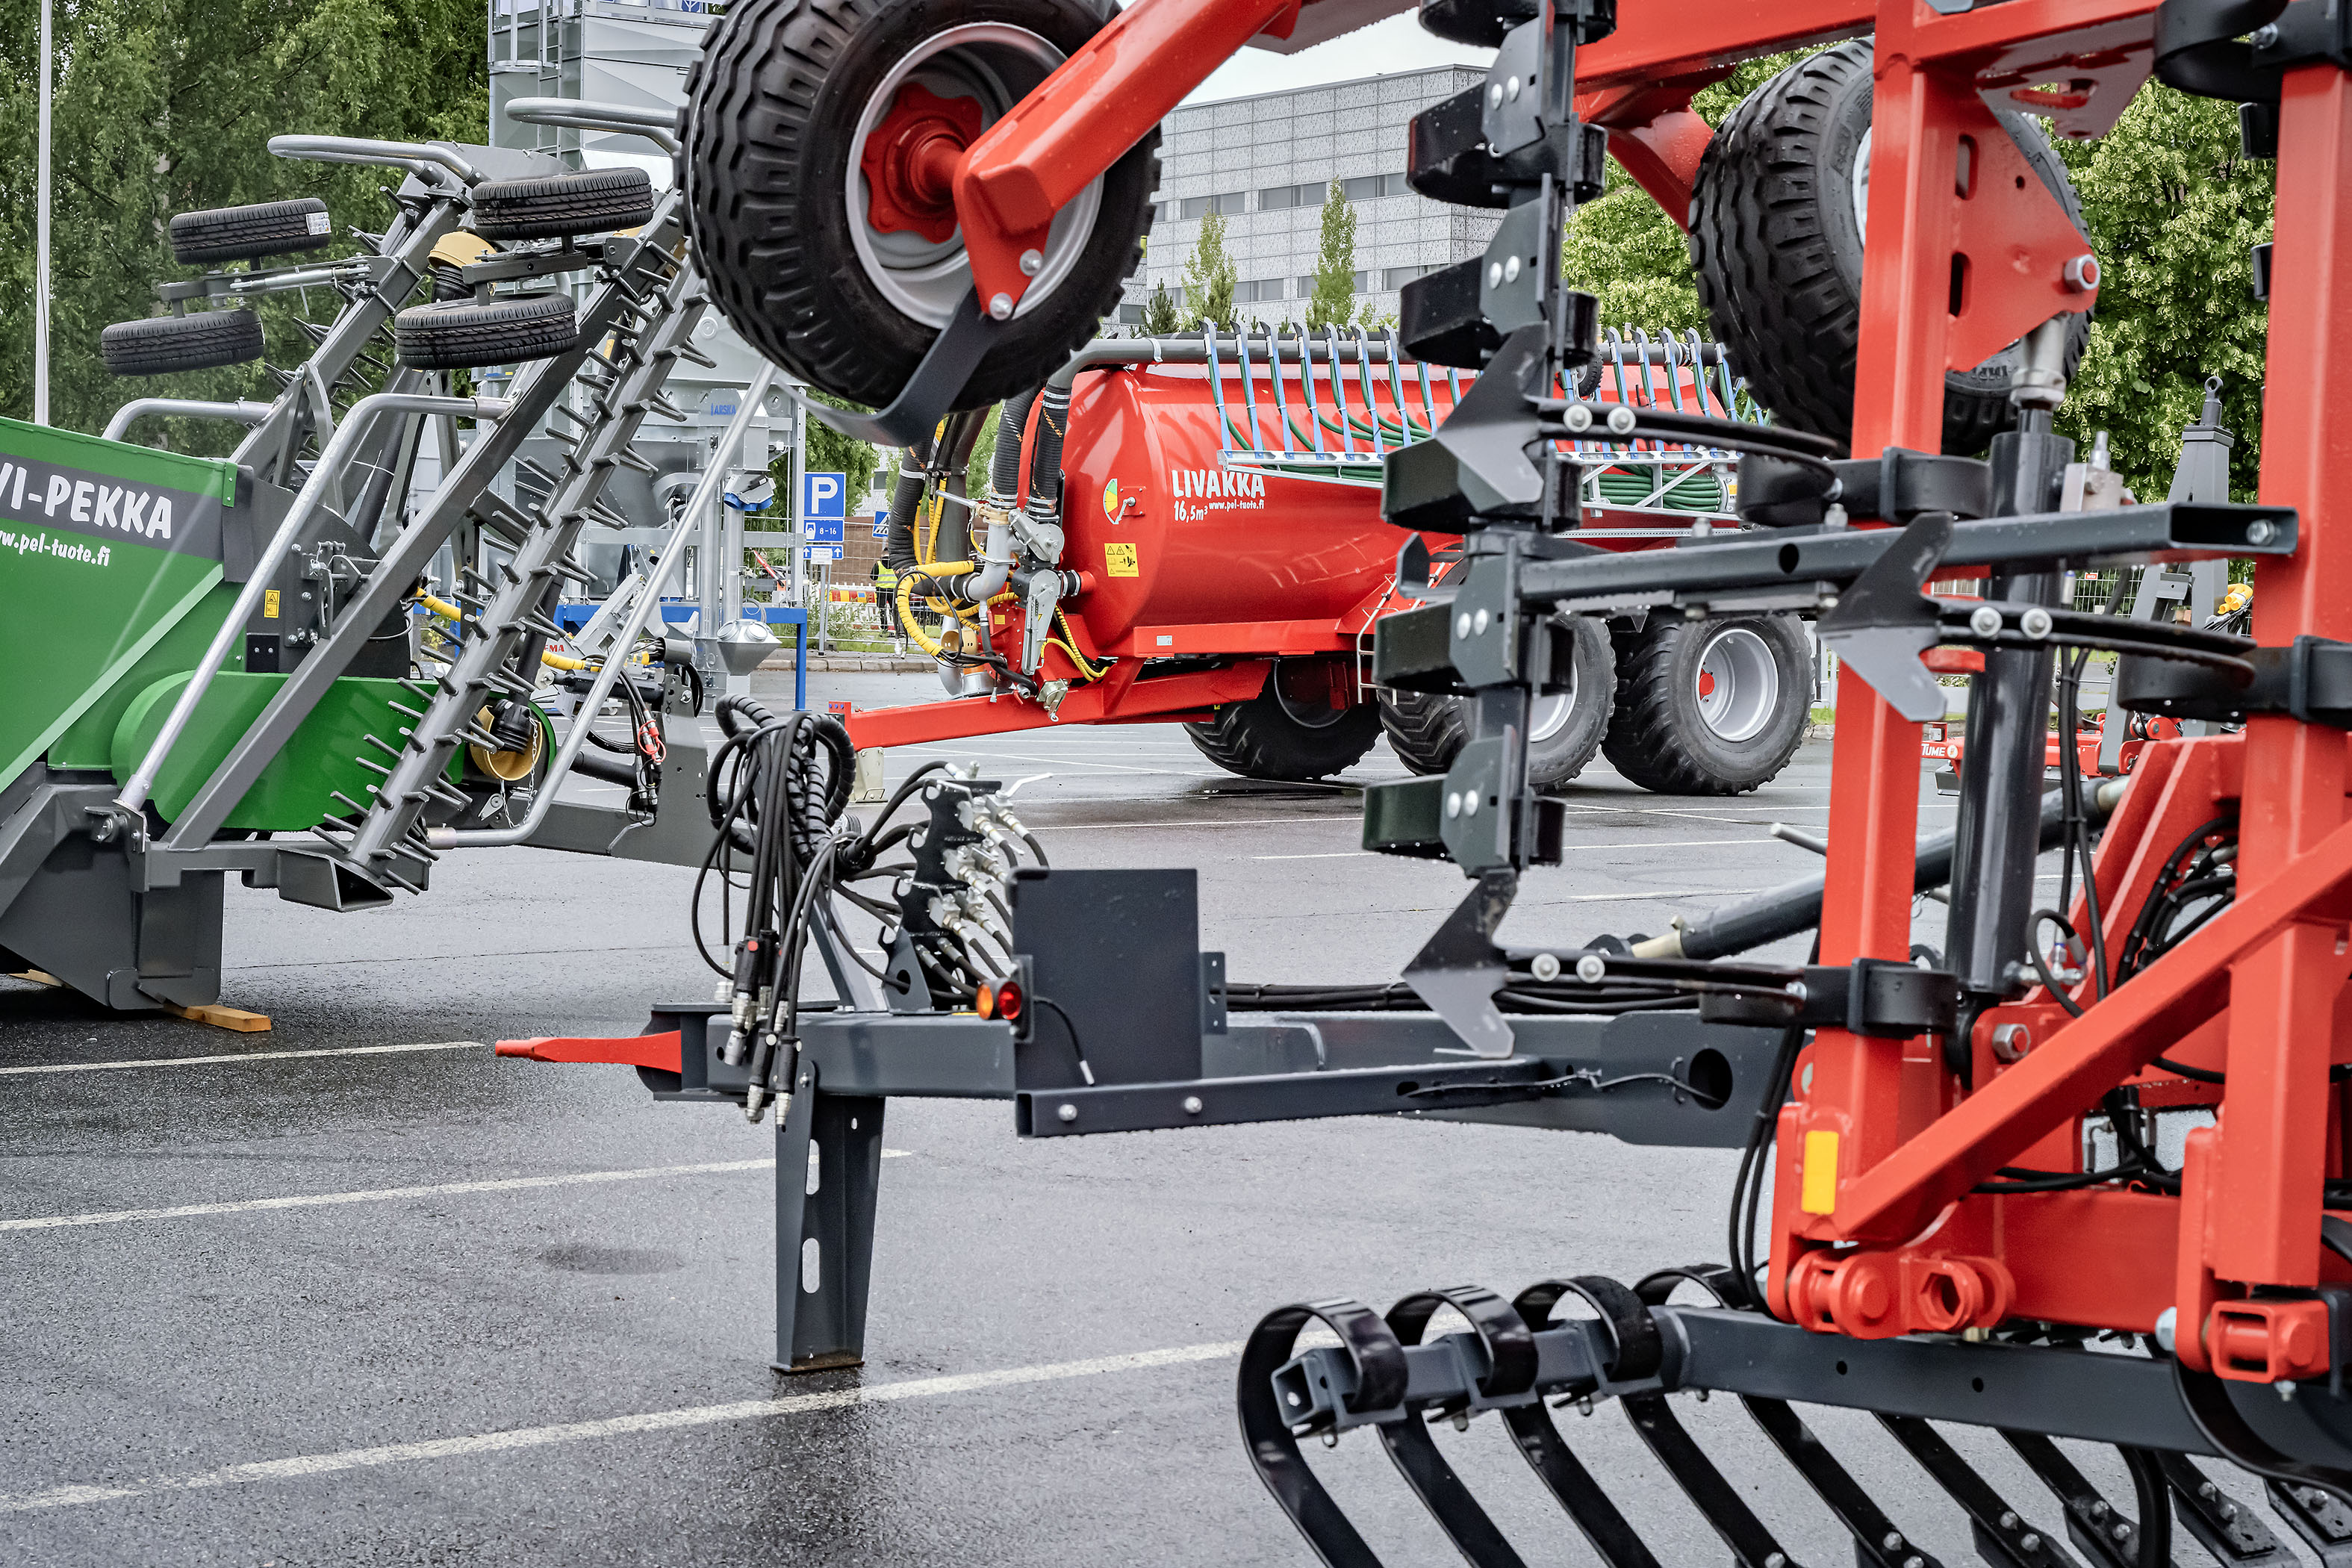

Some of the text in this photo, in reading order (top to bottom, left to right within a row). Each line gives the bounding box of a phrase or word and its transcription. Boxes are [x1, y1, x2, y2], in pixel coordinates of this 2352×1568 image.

[812, 477, 838, 514] P
[1172, 469, 1266, 499] LIVAKKA
[1209, 499, 1264, 511] www.pel-tuote.fi
[0, 529, 111, 566] w.pel-tuote.fi
[1921, 743, 1946, 756] TUME
